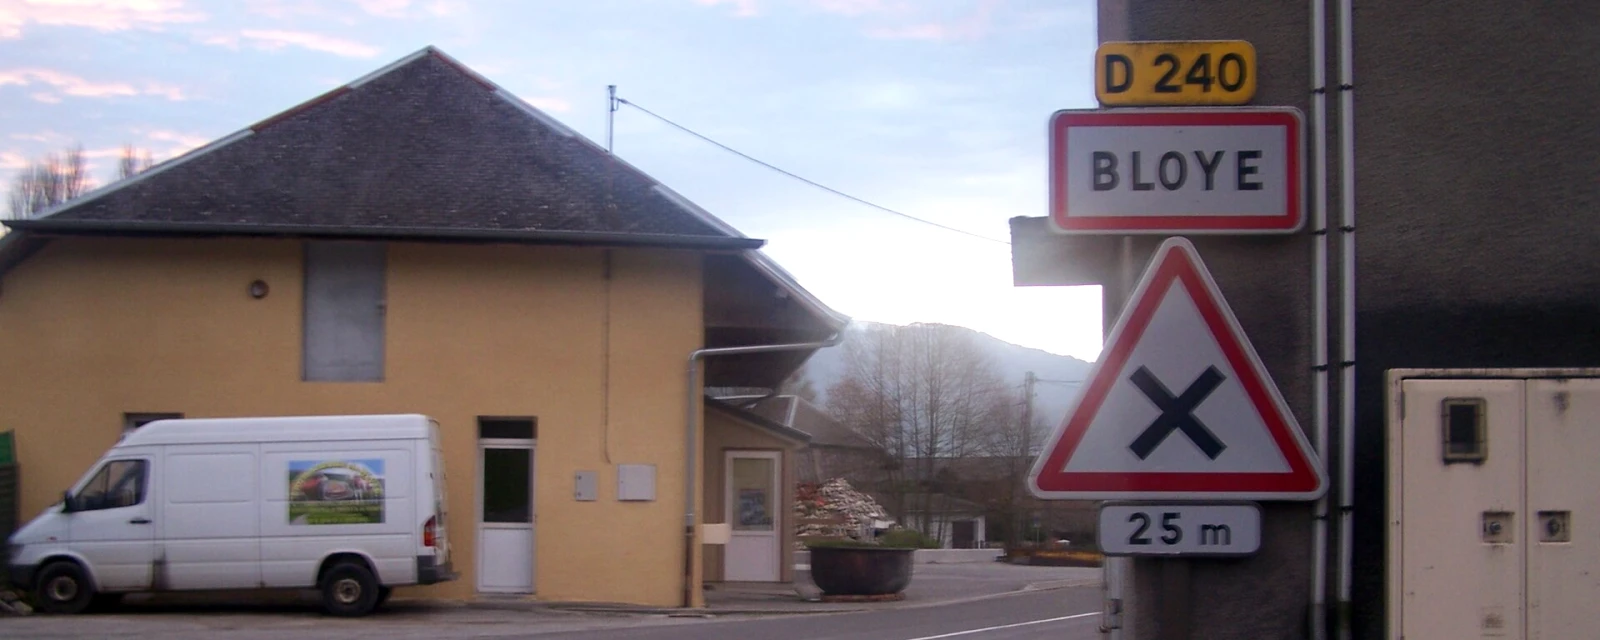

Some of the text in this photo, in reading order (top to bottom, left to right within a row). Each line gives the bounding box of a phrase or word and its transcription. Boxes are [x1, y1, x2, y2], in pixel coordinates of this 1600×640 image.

[1104, 52, 1247, 93] D 240
[1091, 150, 1263, 191] BLOYE
[1127, 512, 1231, 545] 25 m
